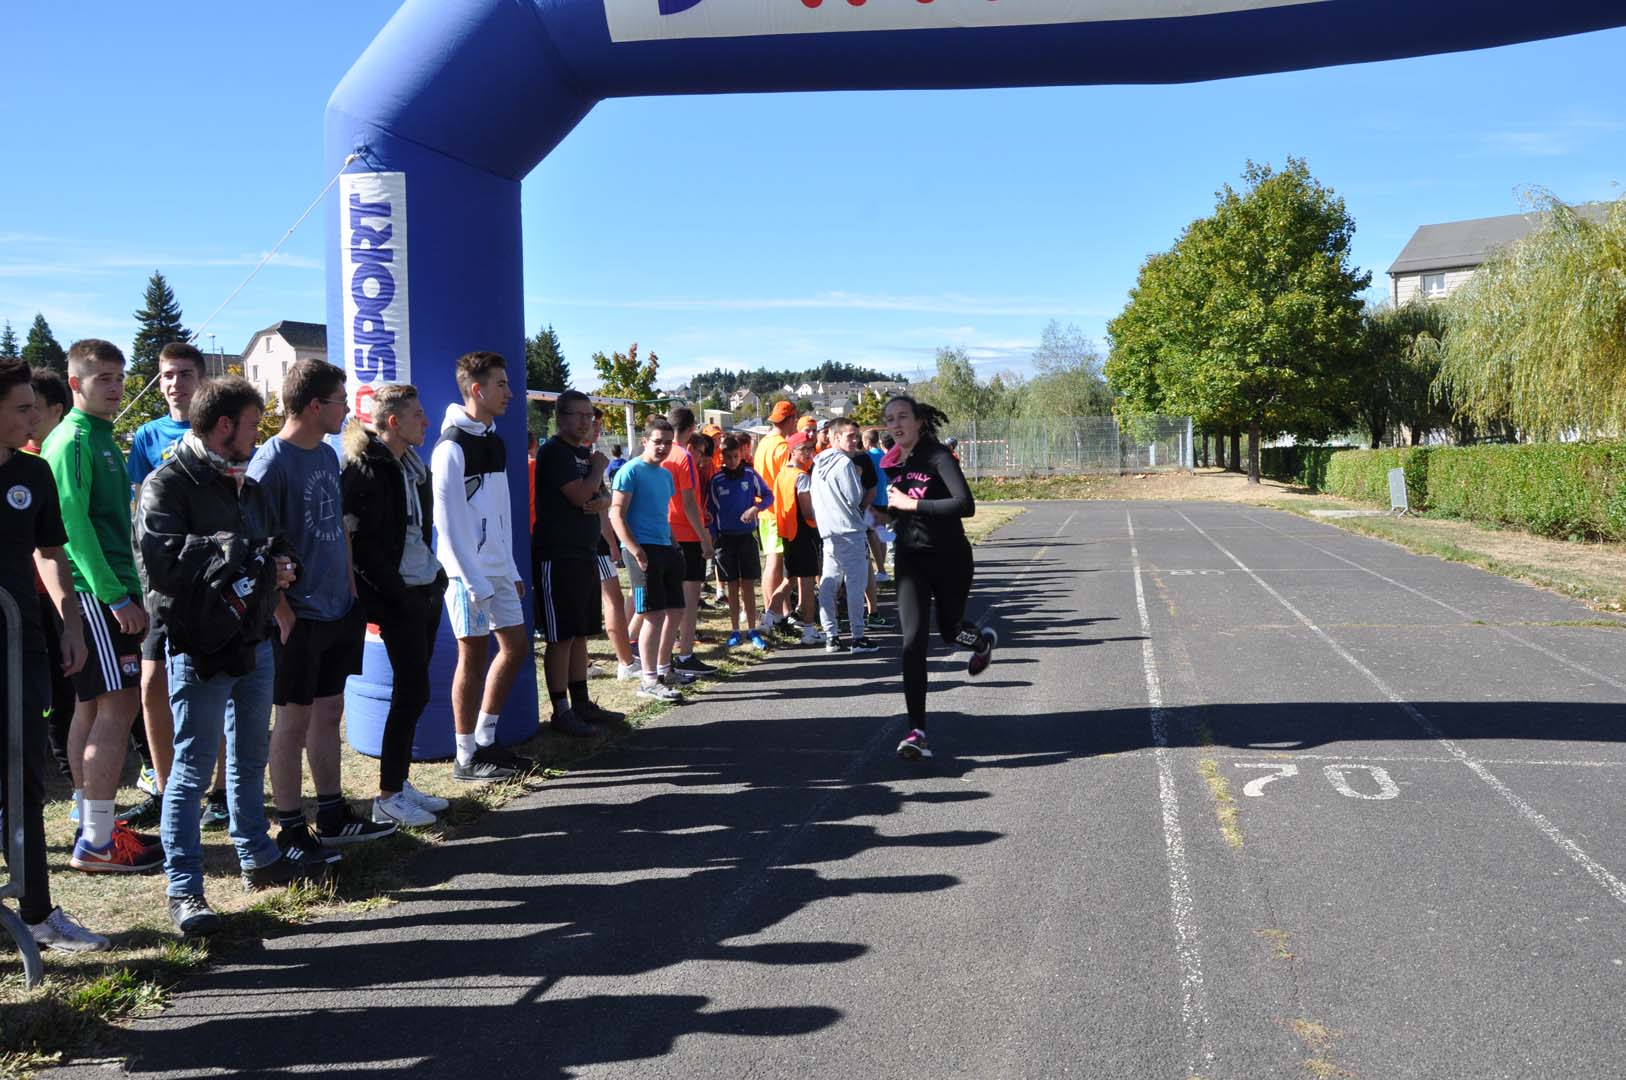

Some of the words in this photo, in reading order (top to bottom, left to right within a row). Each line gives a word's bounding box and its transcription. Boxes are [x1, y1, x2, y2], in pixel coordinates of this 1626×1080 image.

[906, 471, 932, 483] ONLY
[122, 663, 137, 673] OL
[1234, 763, 1401, 801] 70
